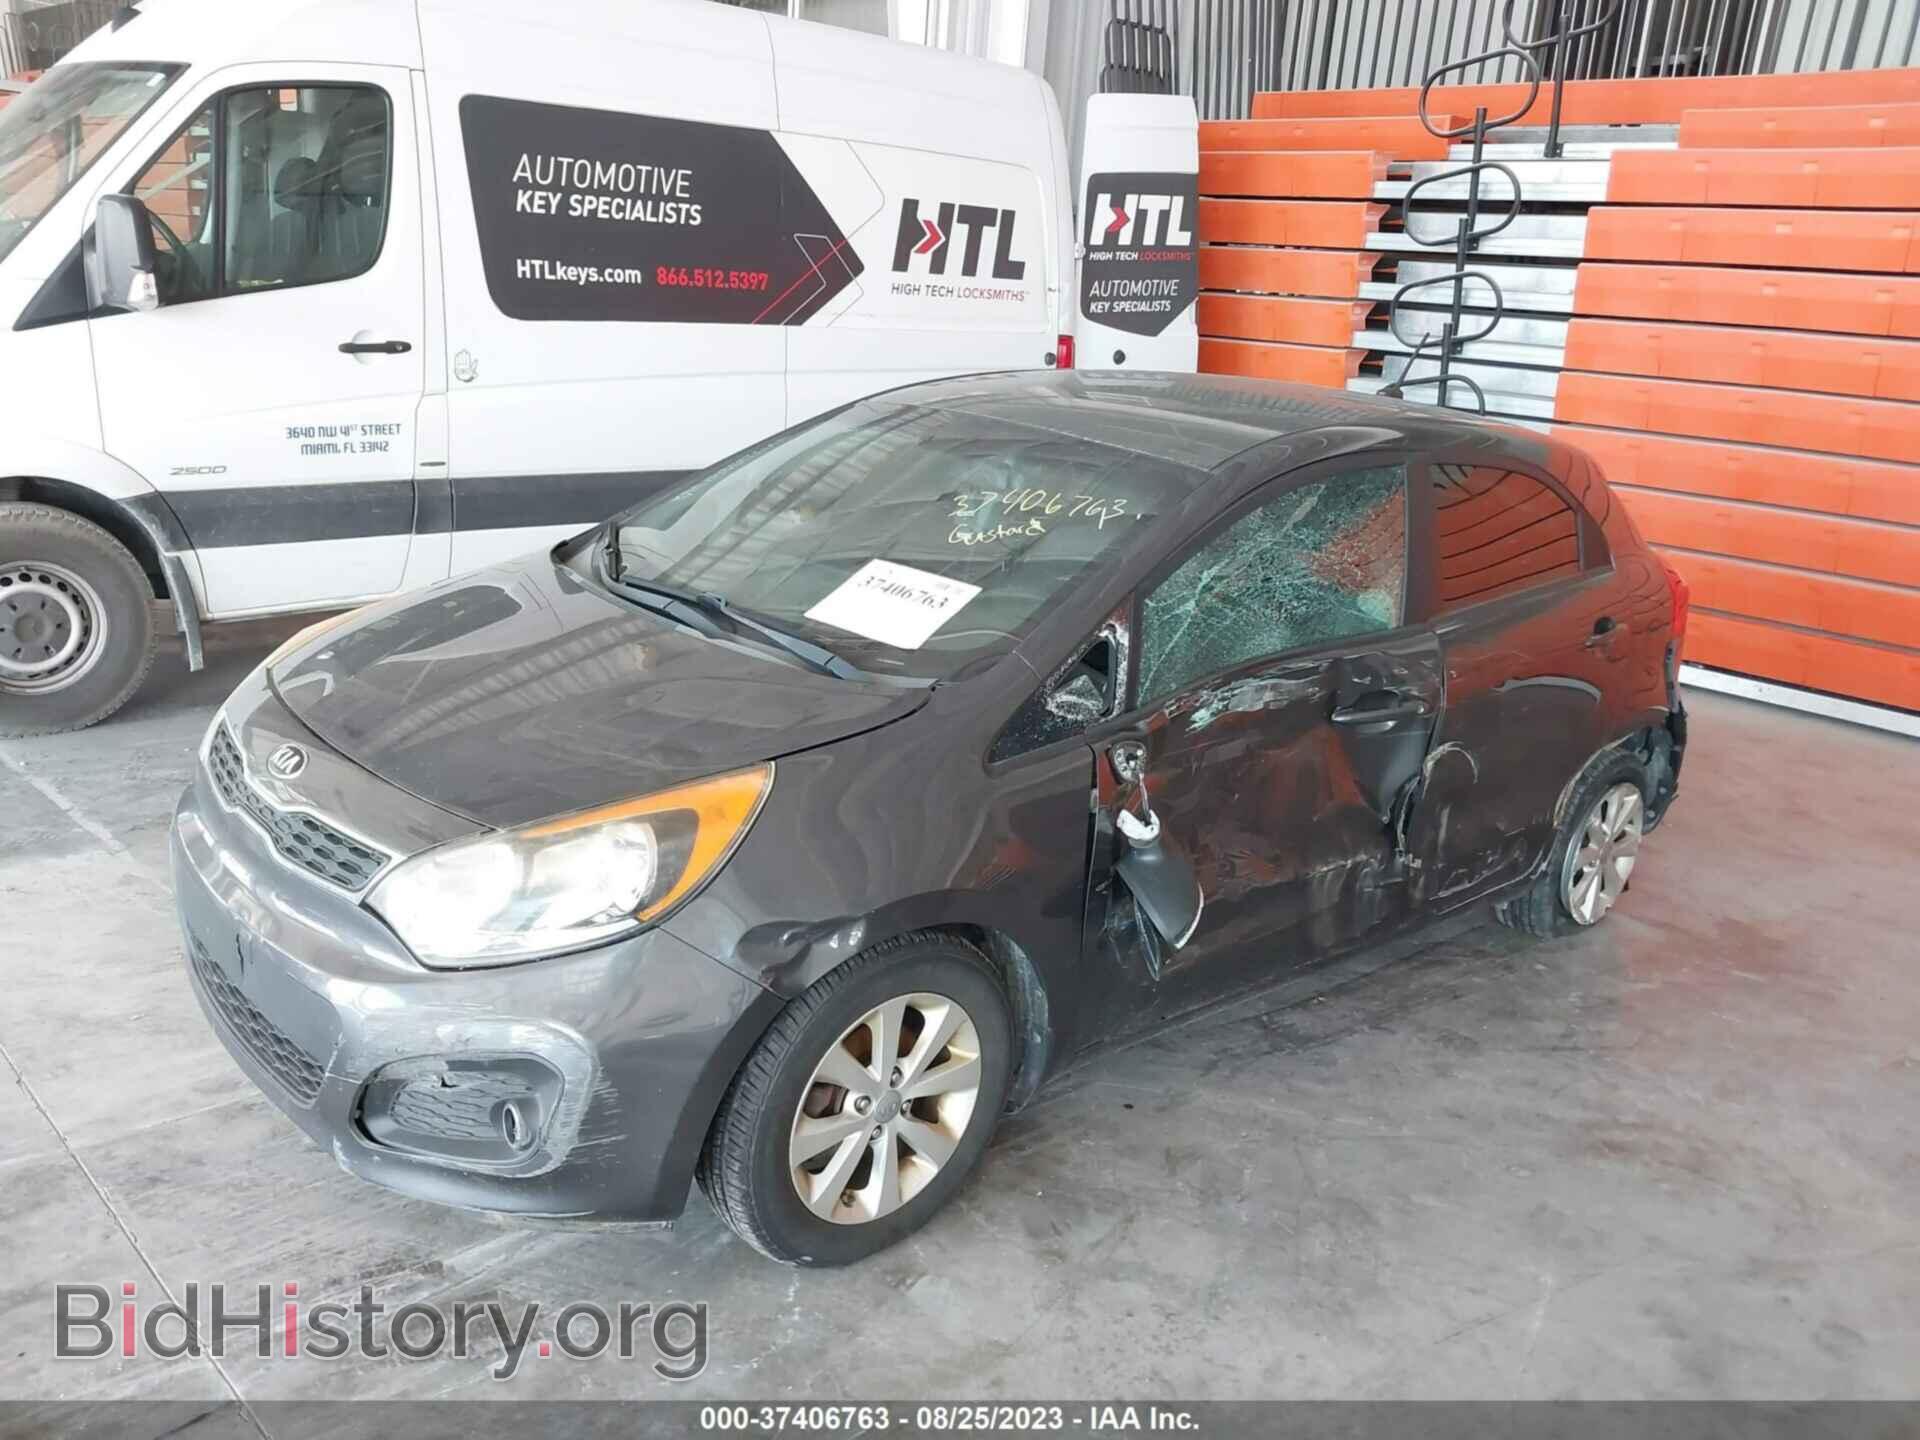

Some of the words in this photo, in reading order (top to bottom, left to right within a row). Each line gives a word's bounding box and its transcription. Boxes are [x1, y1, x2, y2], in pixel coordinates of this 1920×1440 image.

[512, 153, 693, 198] AUTOMOTIVE
[516, 189, 562, 215] KEY
[568, 194, 702, 226] SPECIALISTS
[1089, 193, 1192, 246] HTL
[892, 198, 1026, 280] HTL
[1089, 251, 1113, 261] HIGH
[1115, 251, 1138, 261] TECH
[516, 258, 642, 285] HTLkeys.com
[656, 266, 768, 290] 866.512.5397
[891, 283, 921, 296] HIGH
[925, 285, 954, 298] TECH
[957, 287, 1025, 302] LOCKSMITHS
[1089, 279, 1180, 297] AUTOMOTIVE
[1089, 301, 1110, 313] KEY
[1112, 301, 1172, 312] SPECIALISTS
[287, 426, 315, 439] 3640
[318, 425, 337, 438] NW
[360, 423, 402, 436] STREET
[343, 442, 357, 454] FL
[359, 440, 390, 453] 33142
[168, 465, 227, 475] 2500
